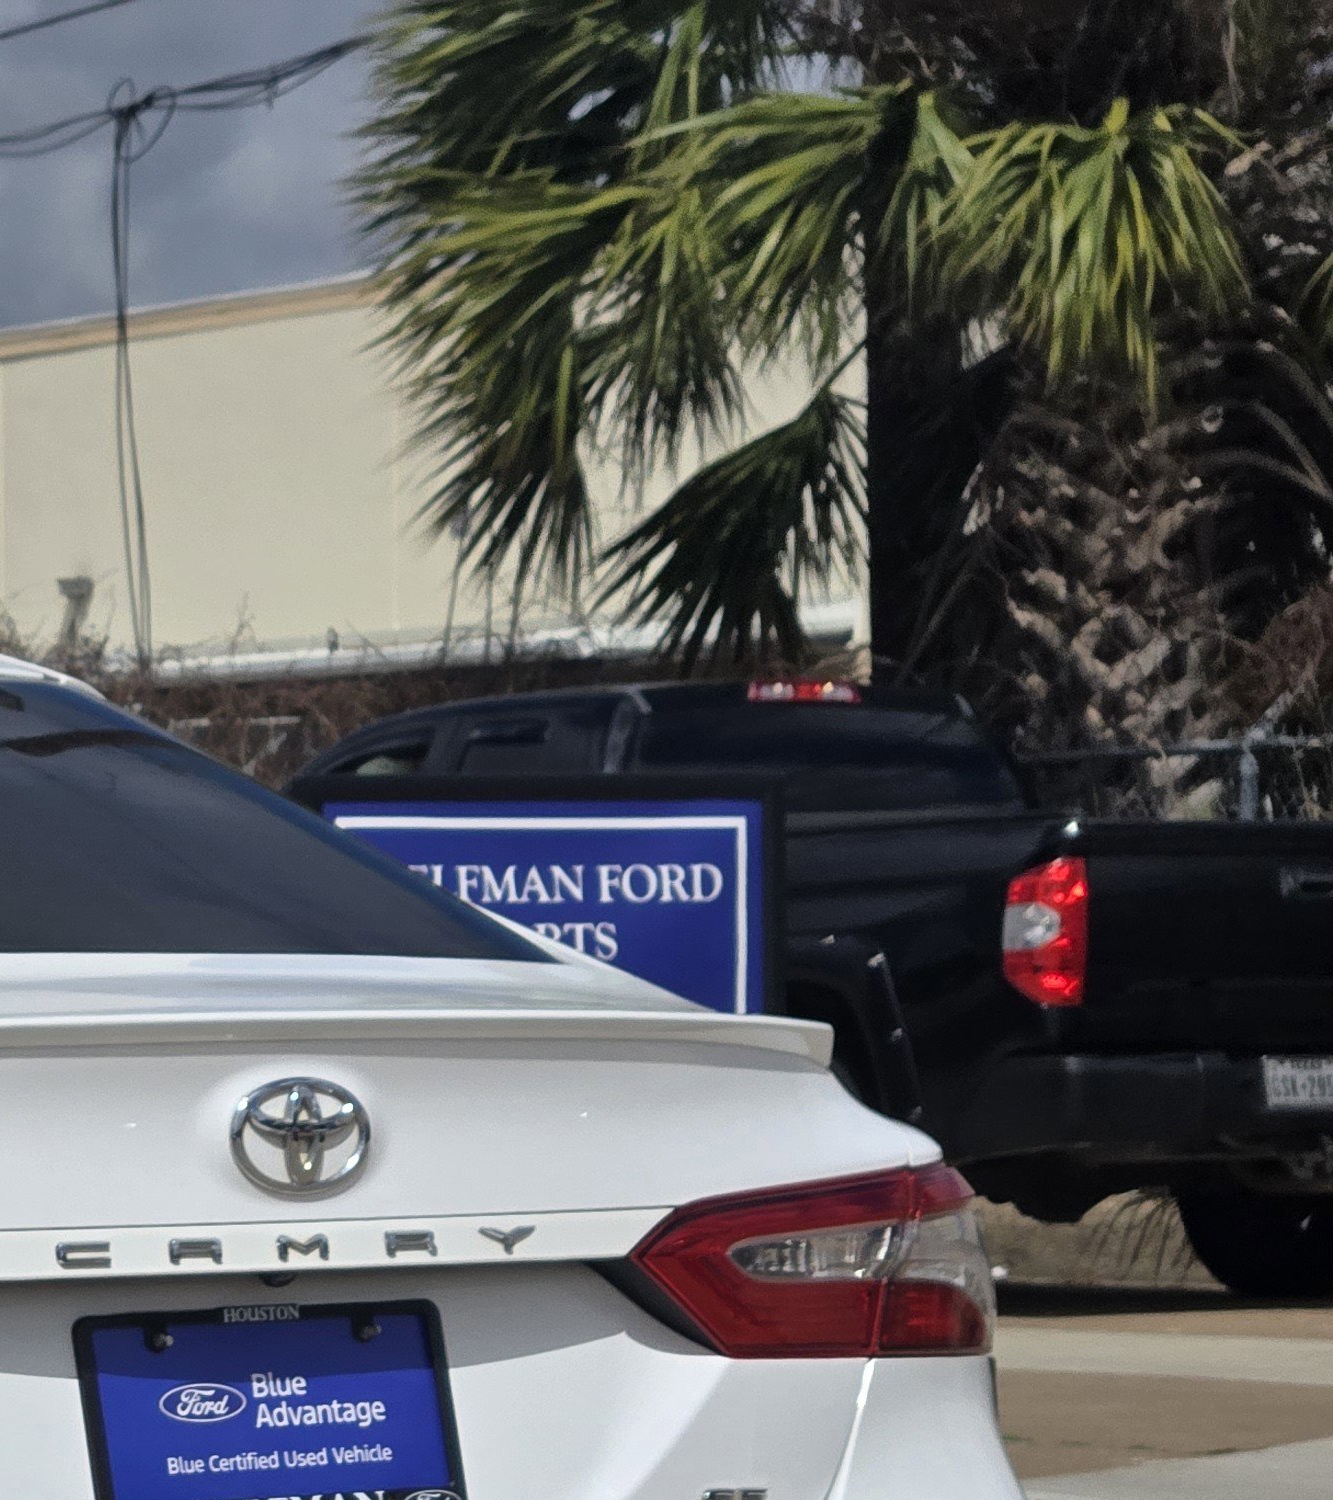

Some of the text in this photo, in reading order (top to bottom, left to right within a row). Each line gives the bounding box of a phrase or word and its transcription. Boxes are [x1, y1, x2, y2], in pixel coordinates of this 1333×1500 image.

[407, 863, 724, 904] FMAN FORD
[55, 1225, 535, 1269] CAMRY
[223, 1305, 300, 1323] HOUSTON
[251, 1372, 308, 1398] Blue
[176, 1388, 230, 1416] Ford
[255, 1400, 386, 1428] Advantage
[167, 1443, 394, 1475] Blue Certified Used Vehicle
